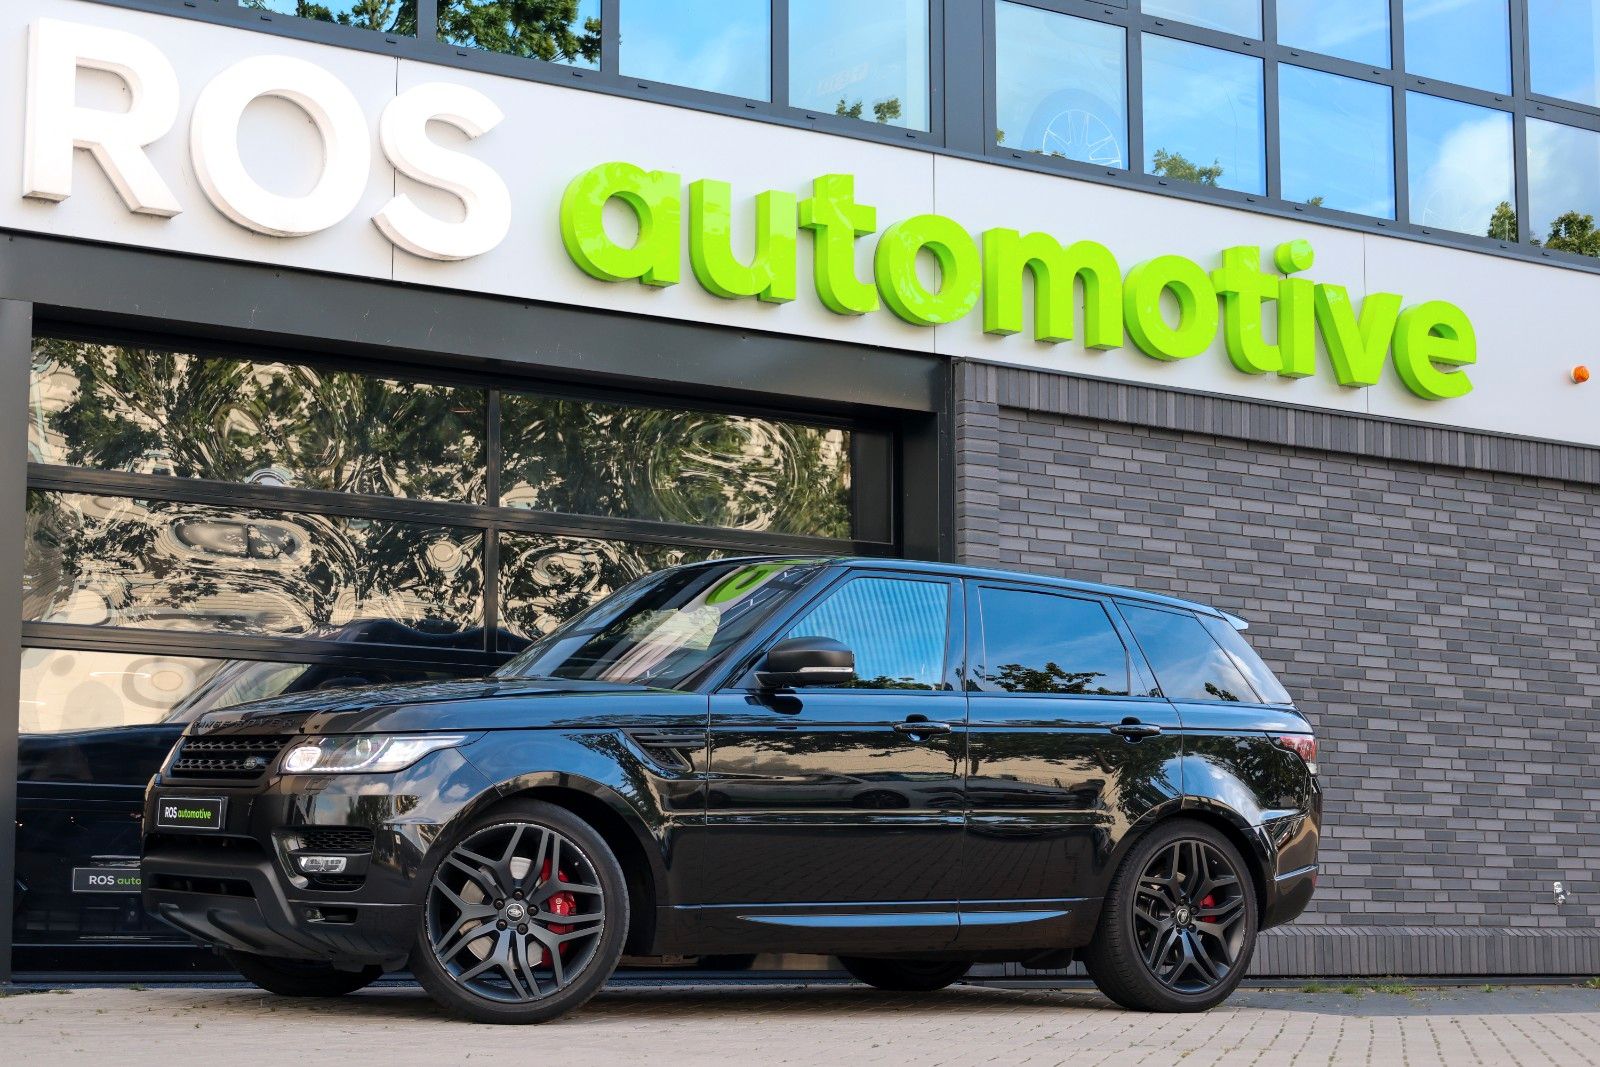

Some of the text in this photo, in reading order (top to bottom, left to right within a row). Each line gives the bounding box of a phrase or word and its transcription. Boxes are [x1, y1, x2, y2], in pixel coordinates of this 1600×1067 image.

[23, 17, 1477, 400] ROS automotive
[165, 807, 211, 819] ROS automotive
[89, 876, 115, 885] ROS
